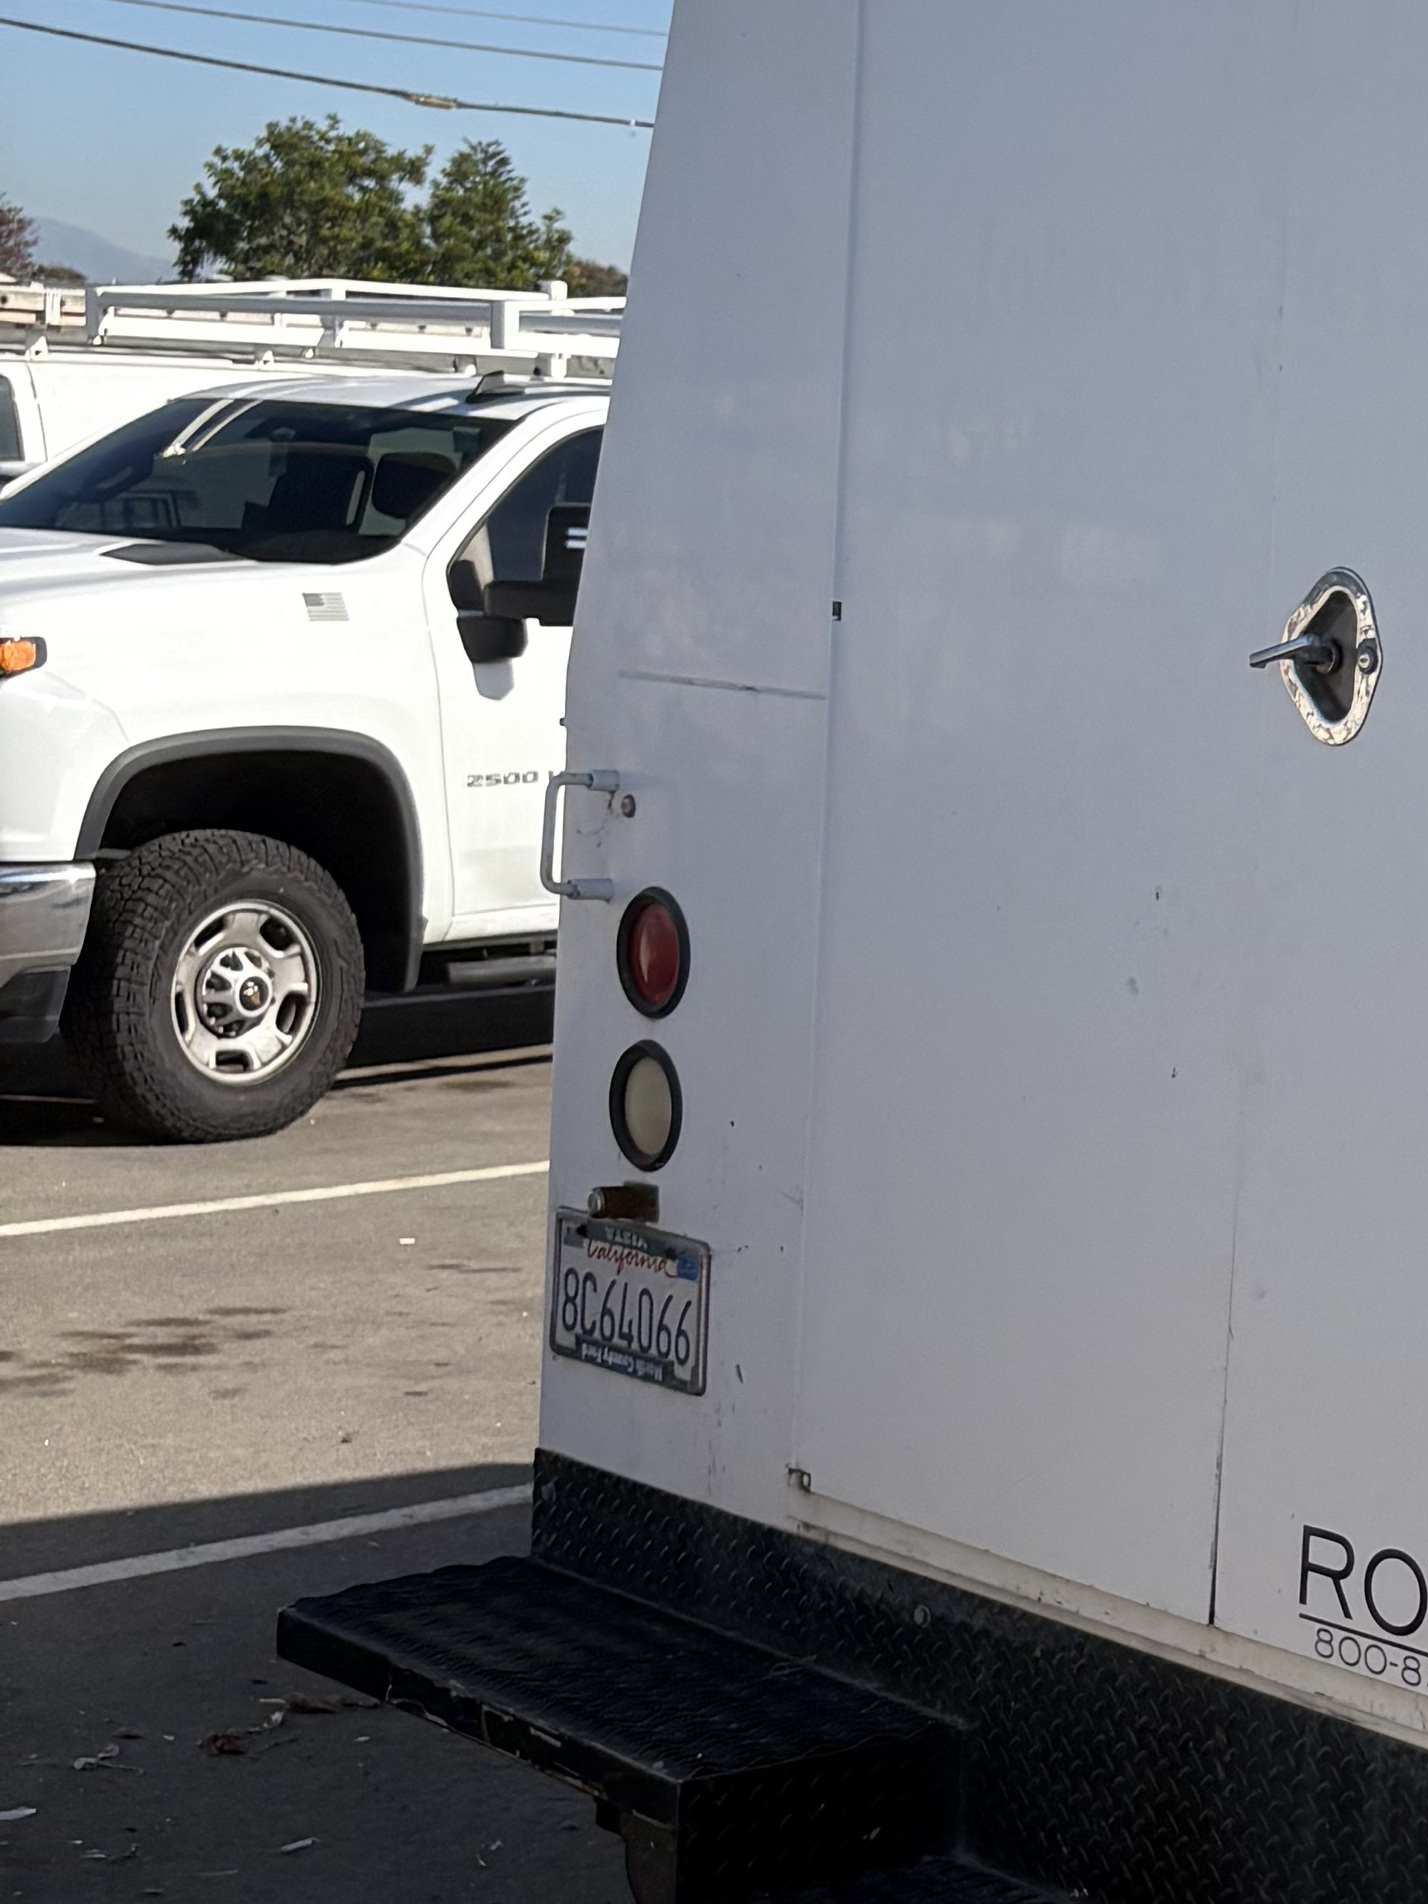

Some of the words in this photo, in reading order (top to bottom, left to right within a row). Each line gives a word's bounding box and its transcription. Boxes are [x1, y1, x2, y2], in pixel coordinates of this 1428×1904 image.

[466, 771, 539, 788] 2500
[586, 1237, 678, 1278] California
[562, 1267, 692, 1366] 8C64066
